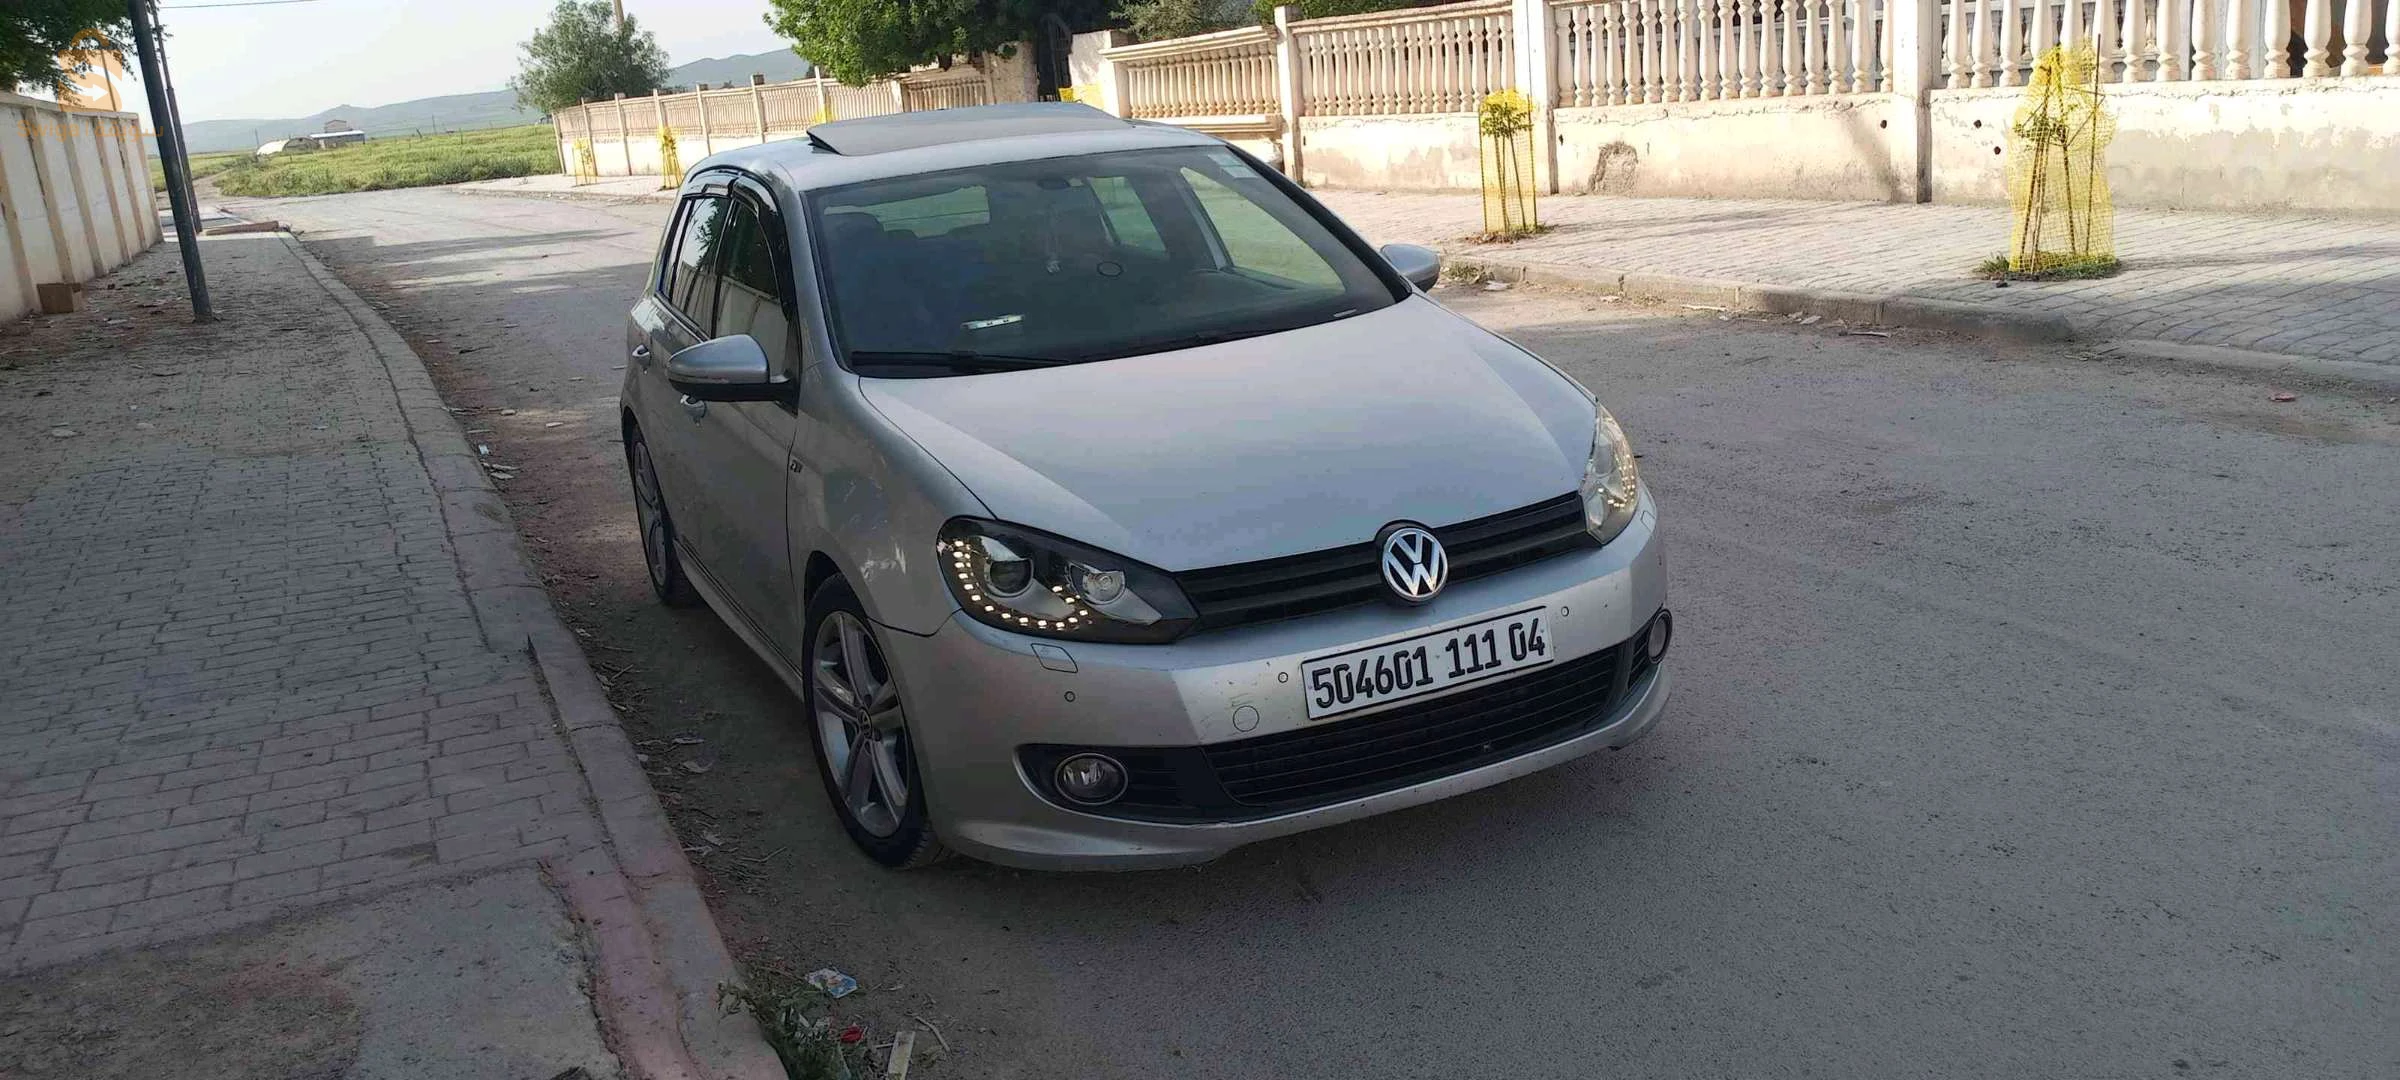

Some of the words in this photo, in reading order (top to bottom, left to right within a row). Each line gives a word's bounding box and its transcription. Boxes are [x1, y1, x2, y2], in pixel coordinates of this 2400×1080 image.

[1382, 528, 1448, 600] VW
[1311, 646, 1434, 709] 504601
[1445, 629, 1502, 679] 111
[1508, 618, 1546, 662] 04
